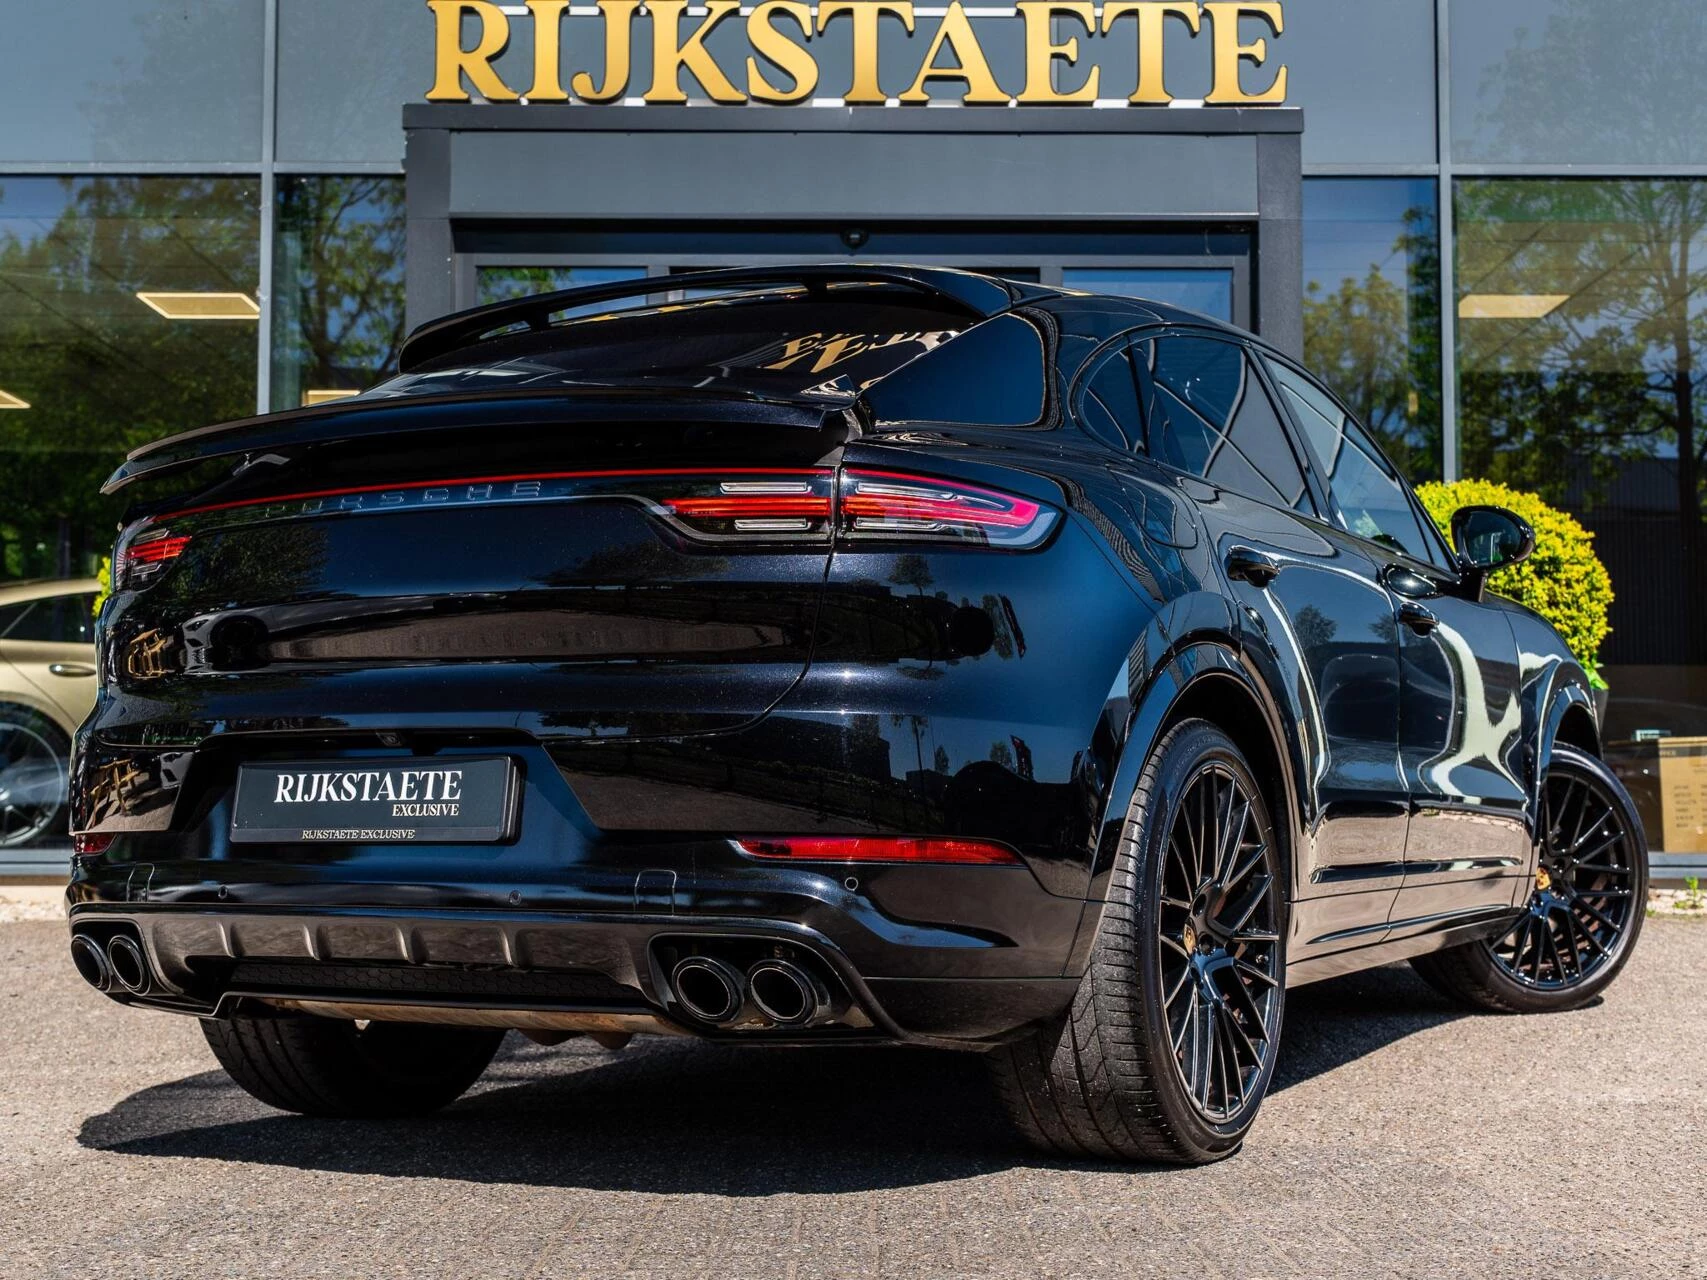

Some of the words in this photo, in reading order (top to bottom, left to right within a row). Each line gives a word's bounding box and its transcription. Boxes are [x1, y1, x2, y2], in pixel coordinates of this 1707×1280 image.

[424, 0, 1288, 105] RIJKSTAETE
[274, 770, 462, 803] RIJKSTAETE
[392, 803, 460, 817] EXCLUSIVE
[302, 829, 358, 840] RIJKSTAETE
[360, 829, 415, 839] EXCLUSIVE
